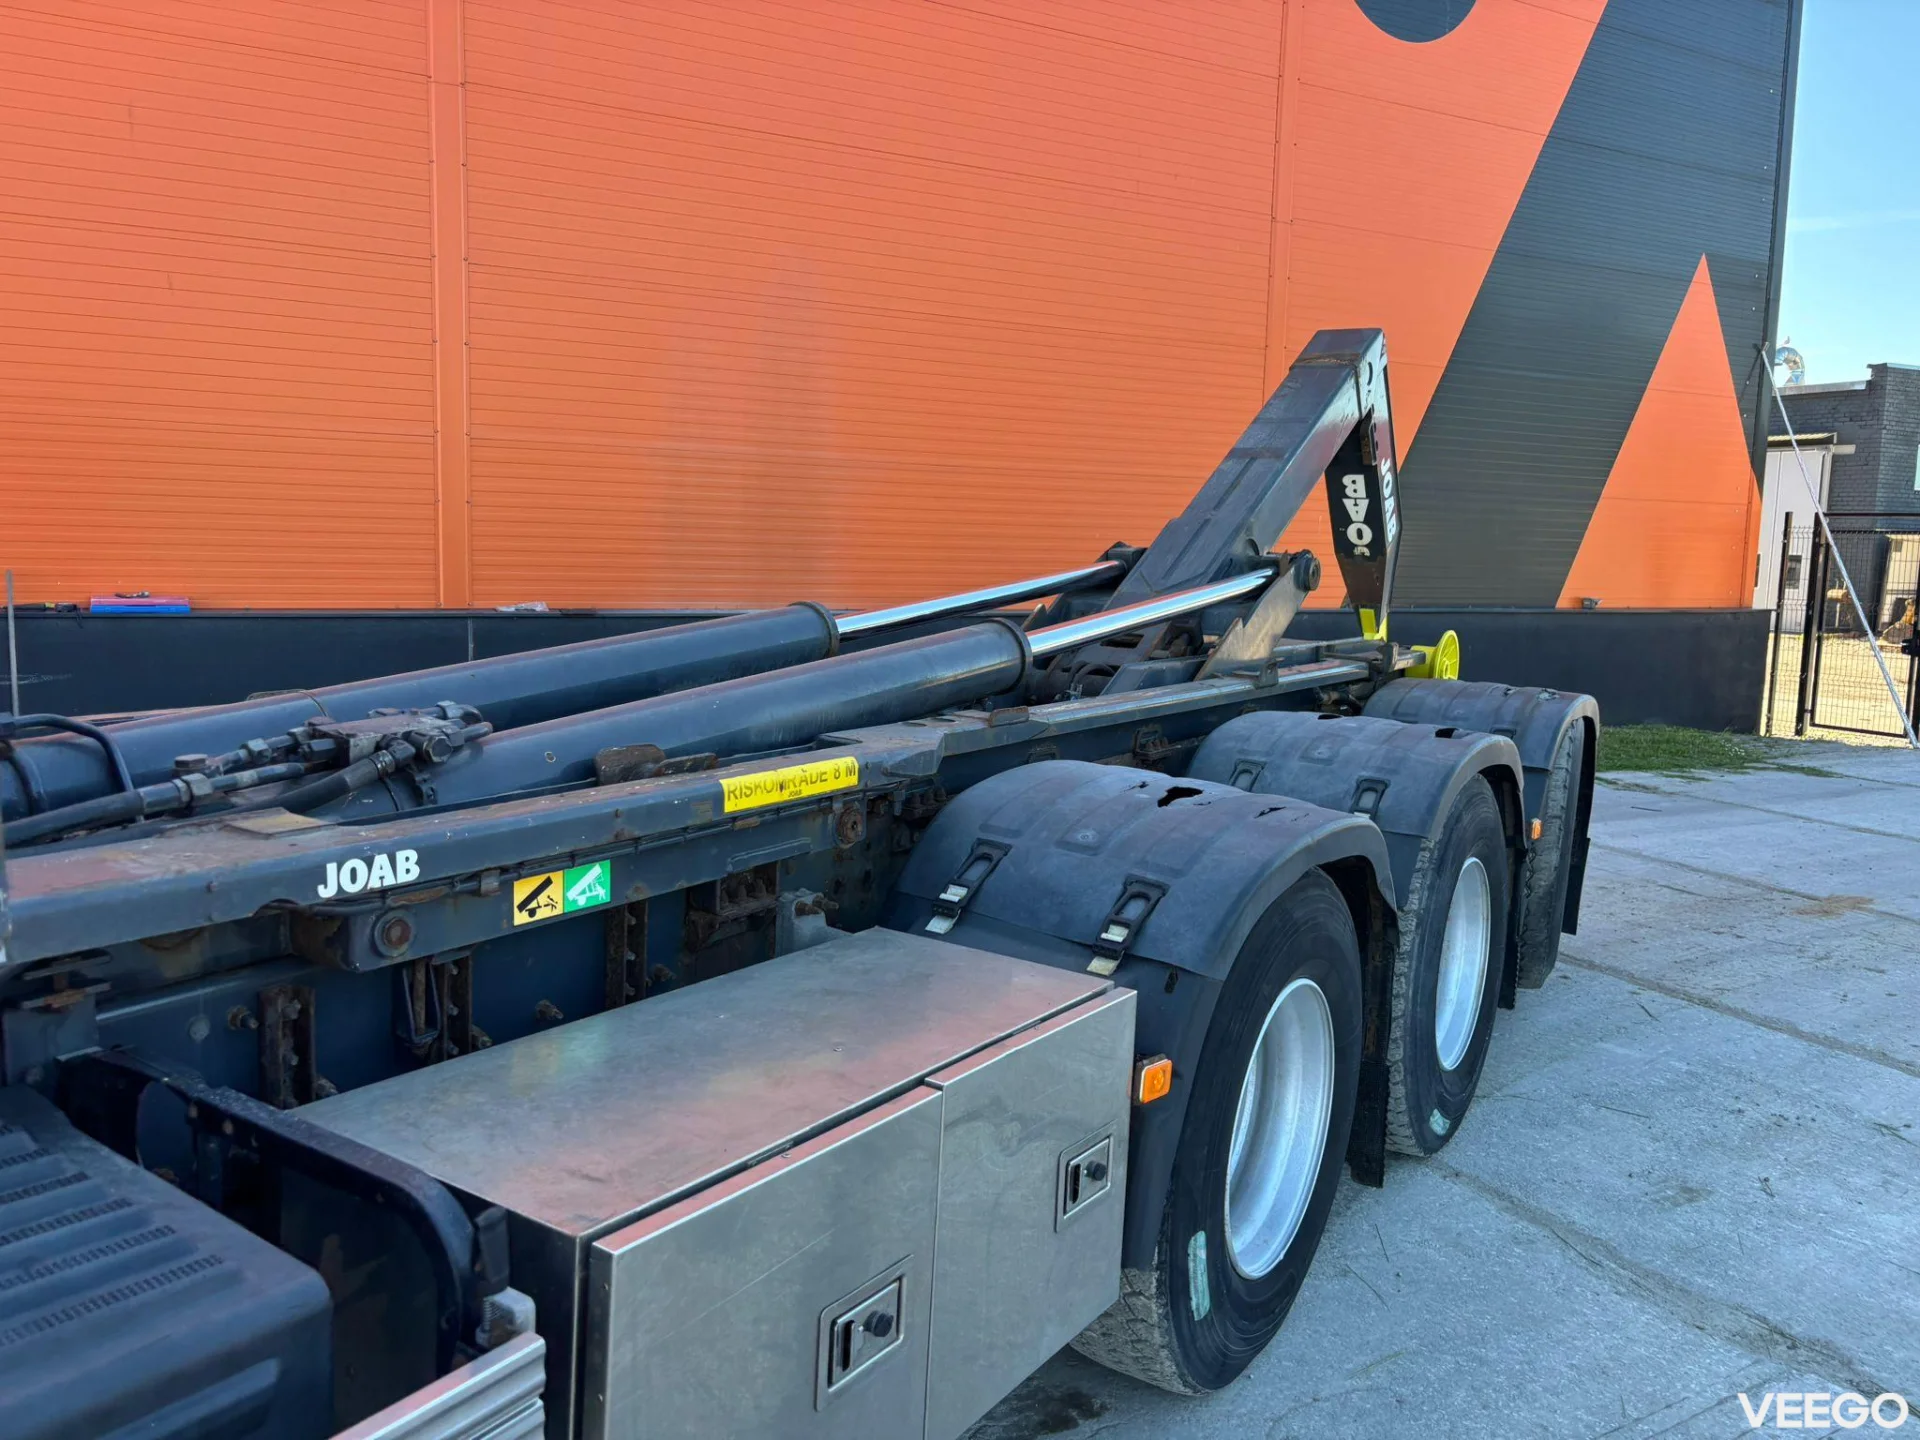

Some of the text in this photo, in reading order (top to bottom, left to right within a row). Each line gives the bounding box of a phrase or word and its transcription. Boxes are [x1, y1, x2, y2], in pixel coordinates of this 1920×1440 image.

[1380, 457, 1396, 543] JOAB
[845, 760, 856, 778] M
[317, 849, 420, 898] JOAB
